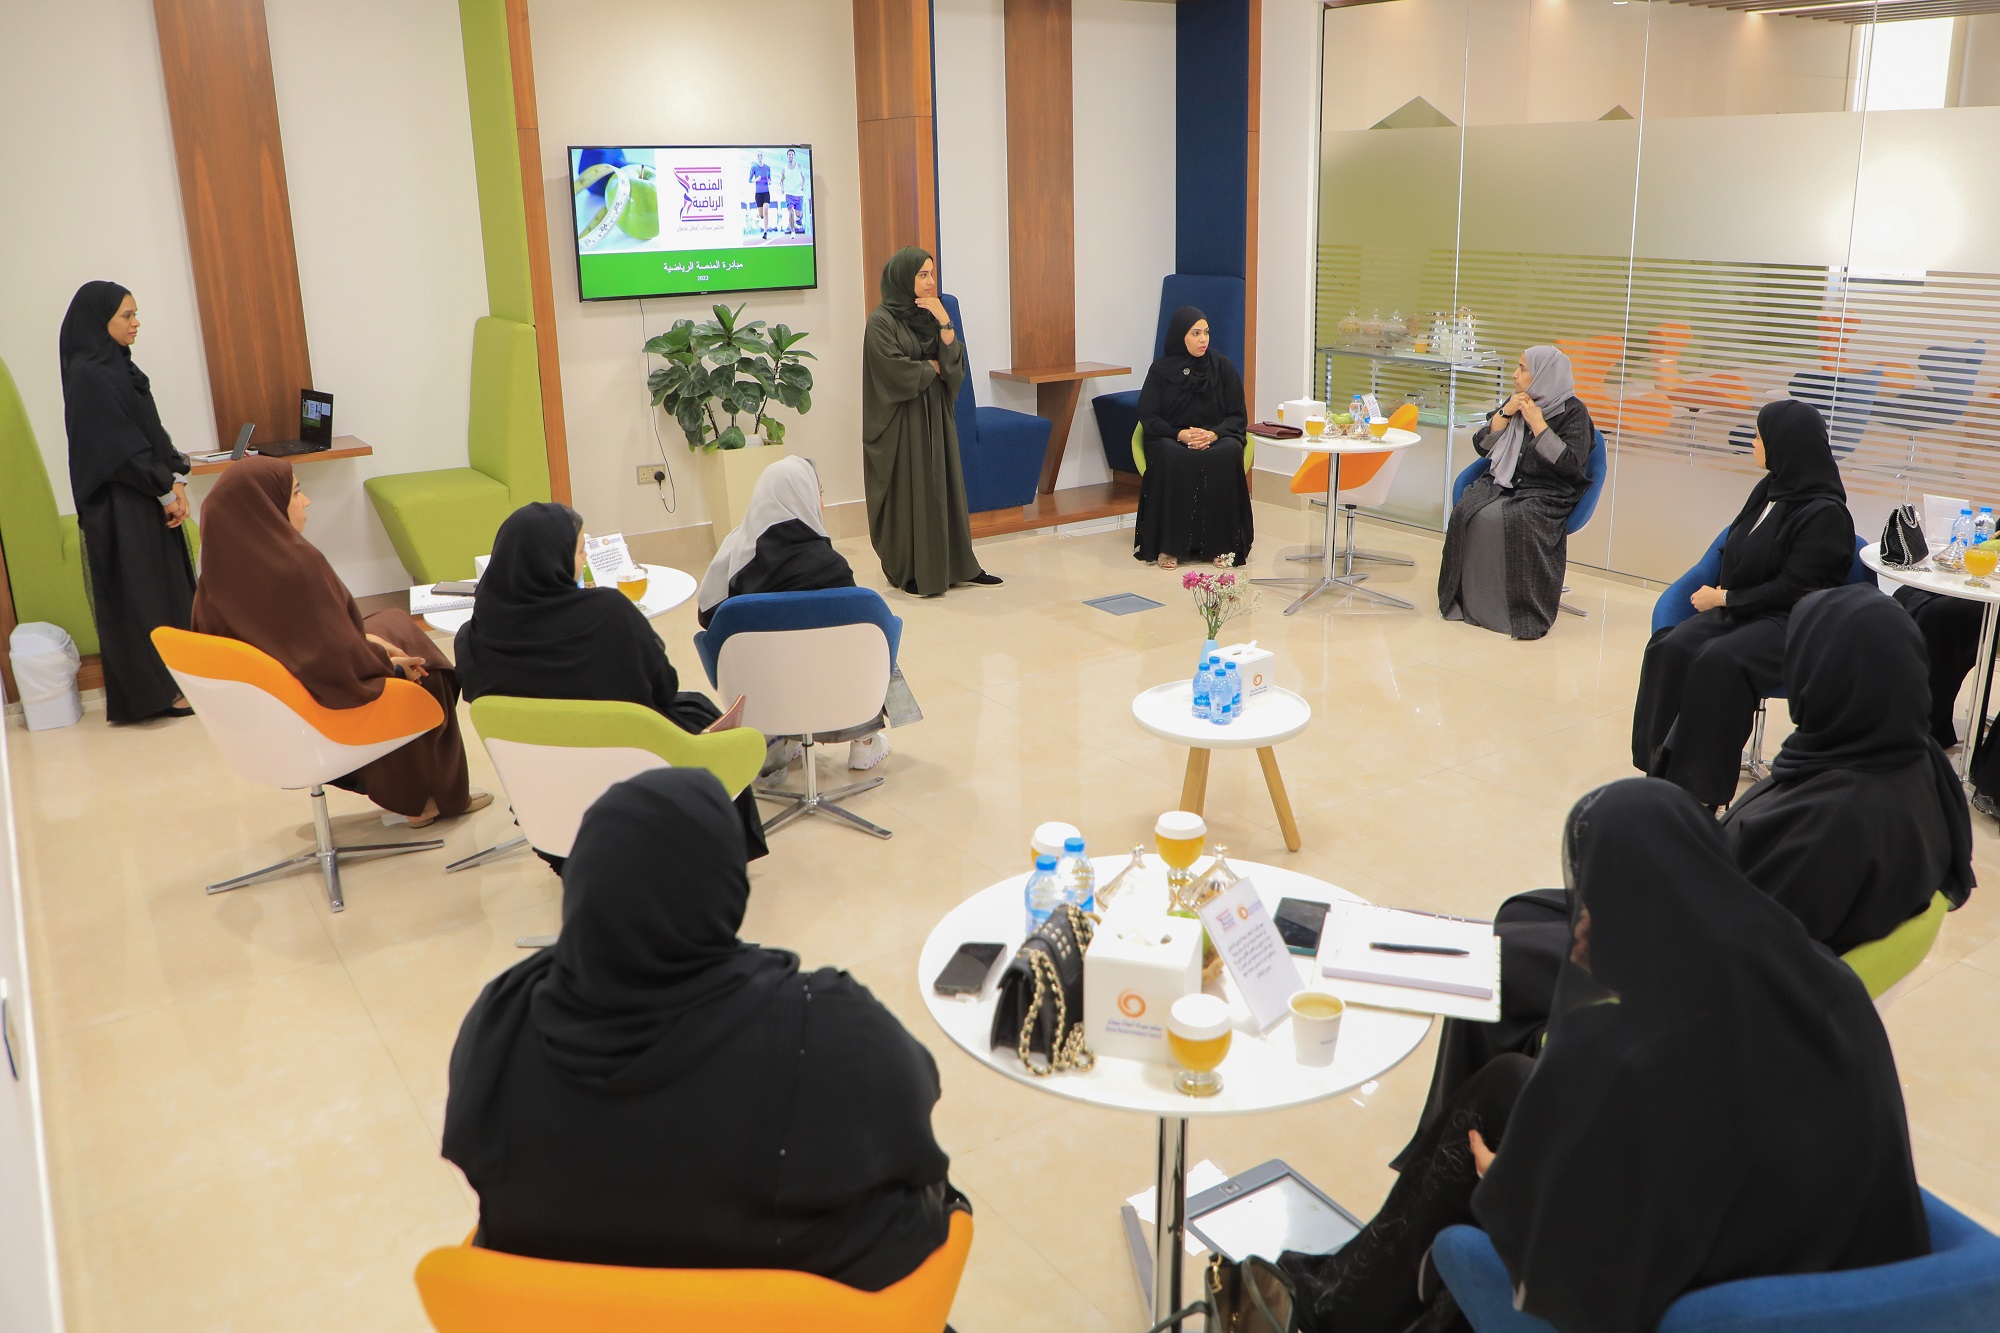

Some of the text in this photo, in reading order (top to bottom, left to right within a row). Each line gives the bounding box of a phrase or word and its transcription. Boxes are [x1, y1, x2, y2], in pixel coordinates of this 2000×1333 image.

[691, 178, 723, 191] المنصة
[692, 195, 724, 212] الرياضية
[663, 260, 744, 274] مبادرة المنصة الرياضية
